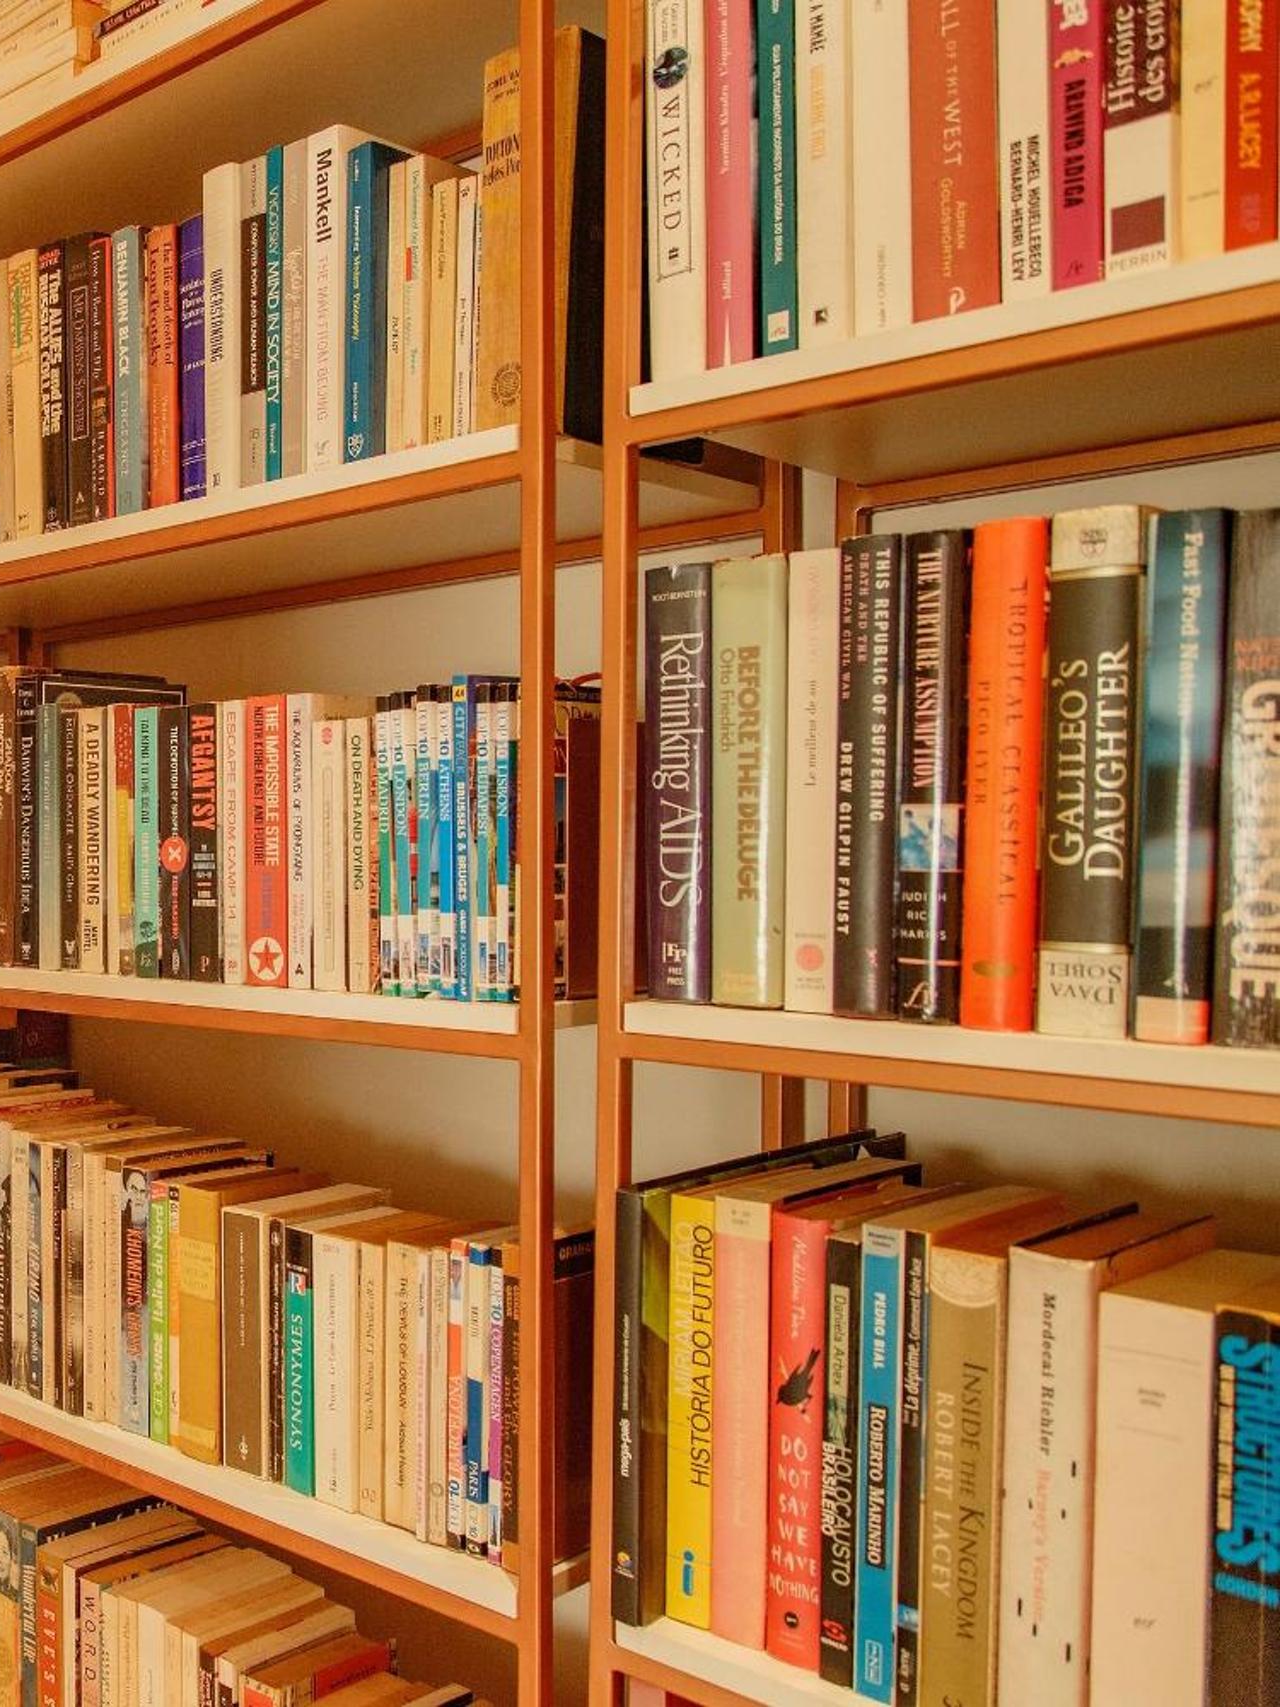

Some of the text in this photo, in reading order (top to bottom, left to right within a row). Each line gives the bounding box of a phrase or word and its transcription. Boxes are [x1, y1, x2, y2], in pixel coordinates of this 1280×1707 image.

[1107, 4, 1135, 113] Histoire
[662, 96, 682, 231] WICKED
[1063, 79, 1087, 209] ARAVIND ADIGA
[940, 178, 953, 277] GOLDSWORTHY
[1026, 135, 1042, 278] MICHEL HOUELLEBECQ
[117, 239, 129, 378] BENJAMIN BLACK
[149, 247, 161, 368] Leon Trotsky
[163, 241, 175, 367] The life and death of
[267, 260, 280, 308] MIND
[1106, 249, 1168, 273] PERRIN
[49, 269, 63, 434] The ALLIES and the
[209, 268, 223, 364] UNDERSTANDING
[267, 312, 279, 331] IN
[266, 335, 279, 405] SOCIETY
[120, 388, 130, 477] VENGEANCE
[841, 554, 853, 701] AMERICAN CIVIL WAR
[856, 552, 870, 662] DEATH AND THE
[719, 648, 736, 753] Otto Friedrich
[868, 548, 891, 823] THIS REPUBLIC OF SUFFERING
[912, 548, 943, 788] THE NURTURE ASSUMPTION
[191, 715, 216, 832] AFGANTSY
[226, 711, 237, 784] ESCAPE
[253, 705, 264, 867] NORTH KOREA PAST AND FUTURE
[265, 704, 280, 867] THE IMPOSSIBLE STATE
[378, 750, 390, 834] 10 MADRID
[395, 744, 406, 836] 10 LONDON
[419, 737, 429, 820] 10 BERLIN
[439, 738, 450, 821] 10 ATHENS
[477, 739, 488, 838] 10 BUDAPEST
[651, 630, 706, 906] Rethinking AIDS
[736, 645, 762, 901] BEFORE THE DELUGE
[973, 680, 991, 806] PICO IYER
[997, 577, 1028, 905] TROPICAL CLASSICAL
[1048, 658, 1089, 866] GALILEO'S
[1083, 641, 1130, 882] DAUGHTER
[20, 736, 33, 915] DARWIN'S DANGEROUS IDEA
[86, 723, 100, 906] A DEADLY WANDERING
[226, 788, 237, 841] FROM
[351, 735, 364, 891] ON DEATH AND DYING
[457, 781, 466, 840] BRUSSELS
[457, 842, 466, 852] &
[836, 740, 853, 935] DREW GILPIN FAUST
[226, 845, 237, 898] CAMP
[457, 854, 467, 902] BRUGES
[1045, 961, 1123, 983] SOBEL
[1048, 982, 1116, 1005] DAVA
[289, 1312, 304, 1451] SYNONYMES
[491, 1304, 503, 1422] 10 COPENHAGEN
[686, 1223, 712, 1488] HISTÓRIA DO FUTURO
[832, 1293, 847, 1386] Daniela Arbex
[872, 1290, 887, 1369] PEDRO BIAL
[1039, 1292, 1057, 1457] Mordecai Richler
[468, 1459, 478, 1499] PARIS
[777, 1461, 811, 1490] NOT
[779, 1433, 809, 1462] DO
[821, 1439, 836, 1537] BRASILEIRO
[867, 1404, 887, 1565] ROBERTO MARINHO
[931, 1391, 956, 1598] ROBERT LACEY
[956, 1361, 989, 1639] INSIDE THE KINGDOM
[778, 1491, 809, 1517] SAY
[778, 1516, 808, 1548] WE
[831, 1445, 853, 1586] HOLOCAUSTO
[768, 1571, 820, 1605] NOTHING
[770, 1543, 819, 1577] HAVE
[22, 1563, 36, 1664] Wonderful Life
[42, 1608, 57, 1684] EVE'S
[83, 1595, 97, 1683] W.O.R.D.
